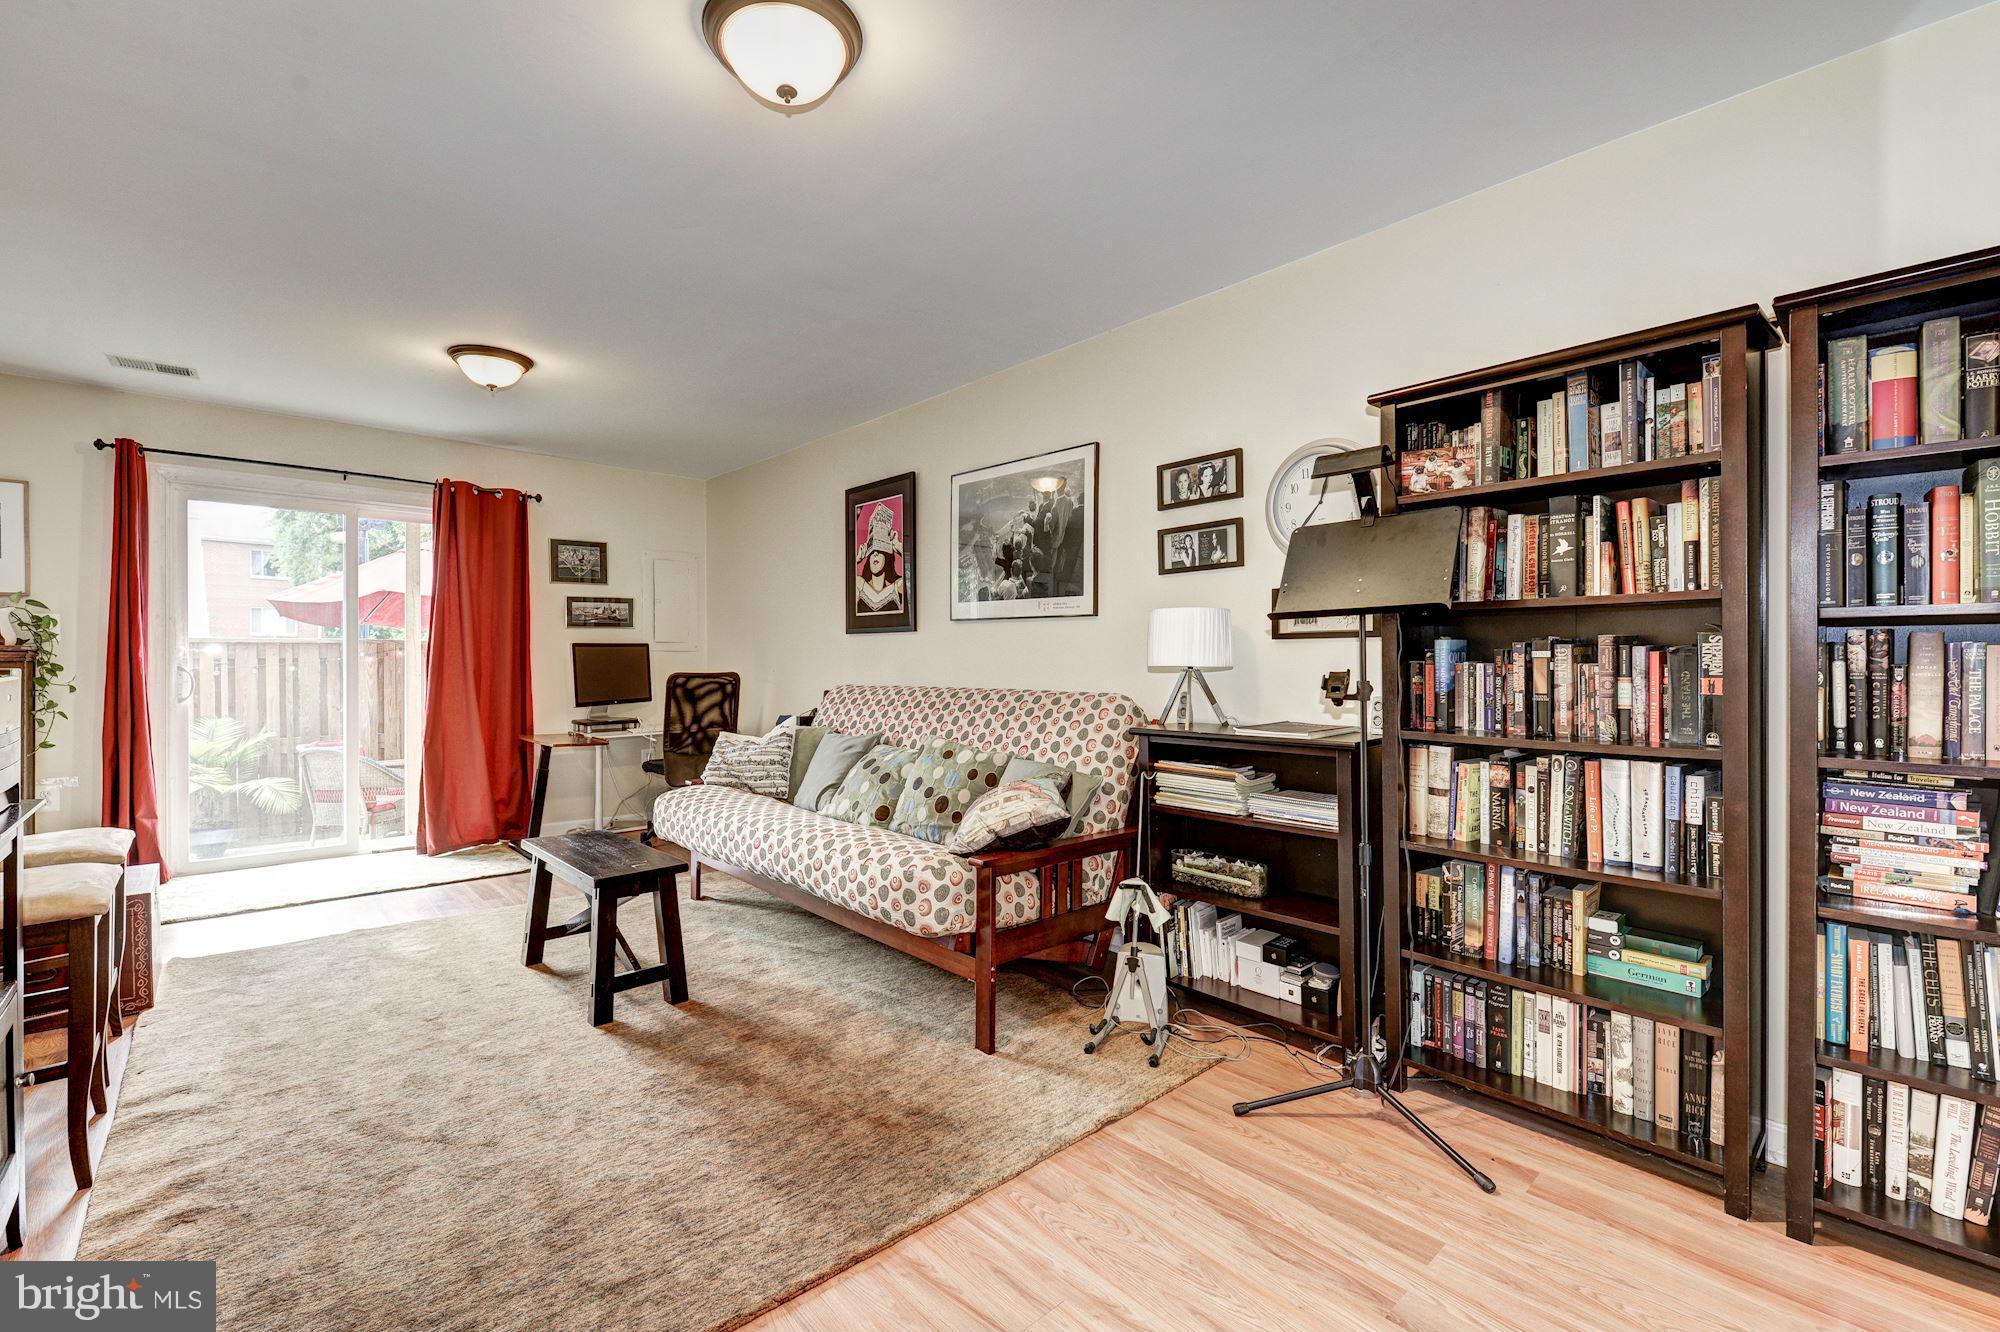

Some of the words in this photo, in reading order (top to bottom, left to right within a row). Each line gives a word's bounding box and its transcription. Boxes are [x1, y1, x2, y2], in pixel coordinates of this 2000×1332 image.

[1967, 372, 2000, 382] HARRY
[1967, 379, 2000, 389] POTTER
[1821, 484, 1834, 498] NEAL
[1286, 502, 1292, 512] 9
[1871, 498, 1899, 506] STROUD
[1821, 498, 1834, 530] STEPHENSON
[1984, 500, 2000, 556] HOBBIT
[1528, 557, 1536, 593] CHABON
[1554, 648, 1567, 678] DUNE
[1702, 643, 1712, 668] KING
[1709, 635, 1723, 676] STEPHEN
[1682, 671, 1690, 702] STAND
[1969, 669, 1981, 692] THE
[1682, 704, 1690, 720] THE
[1969, 694, 1981, 734] PALACE
[1872, 772, 1892, 780] Italian
[1565, 784, 1574, 805] SON
[1691, 782, 1699, 819] chindi
[1850, 789, 1876, 797] New
[1878, 791, 1925, 802] Zealand
[1492, 792, 1501, 830] NARNIA
[1840, 802, 1869, 813] New
[1871, 804, 1926, 820] Zealand
[1563, 814, 1572, 845] WITCH
[1590, 824, 1598, 833] Pi
[1868, 819, 1894, 829] New
[1898, 823, 1946, 835] Zealand
[1888, 834, 1915, 843] Fodor's
[1861, 884, 1908, 898] IRELAND
[1922, 943, 1937, 967] THE
[1831, 953, 1843, 978] SMART
[1628, 968, 1667, 983] German
[1831, 980, 1843, 1012] EXERCISE
[1924, 969, 1941, 1007] CELTS
[1657, 1027, 1677, 1038] ANNE
[1928, 1015, 1938, 1045] DELANEY
[1936, 1015, 1945, 1038] FRANK
[1658, 1037, 1677, 1048] RICE
[1684, 1055, 1708, 1064] WITCHING
[1684, 1093, 1707, 1106] ANNE
[1685, 1104, 1705, 1116] RICE
[1947, 1103, 1958, 1119] WILL
[1892, 1130, 1903, 1145] EVE
[1950, 1133, 1961, 1147] The
[1945, 1148, 1960, 1179] Leveling
[1945, 1180, 1957, 1203] Wind
